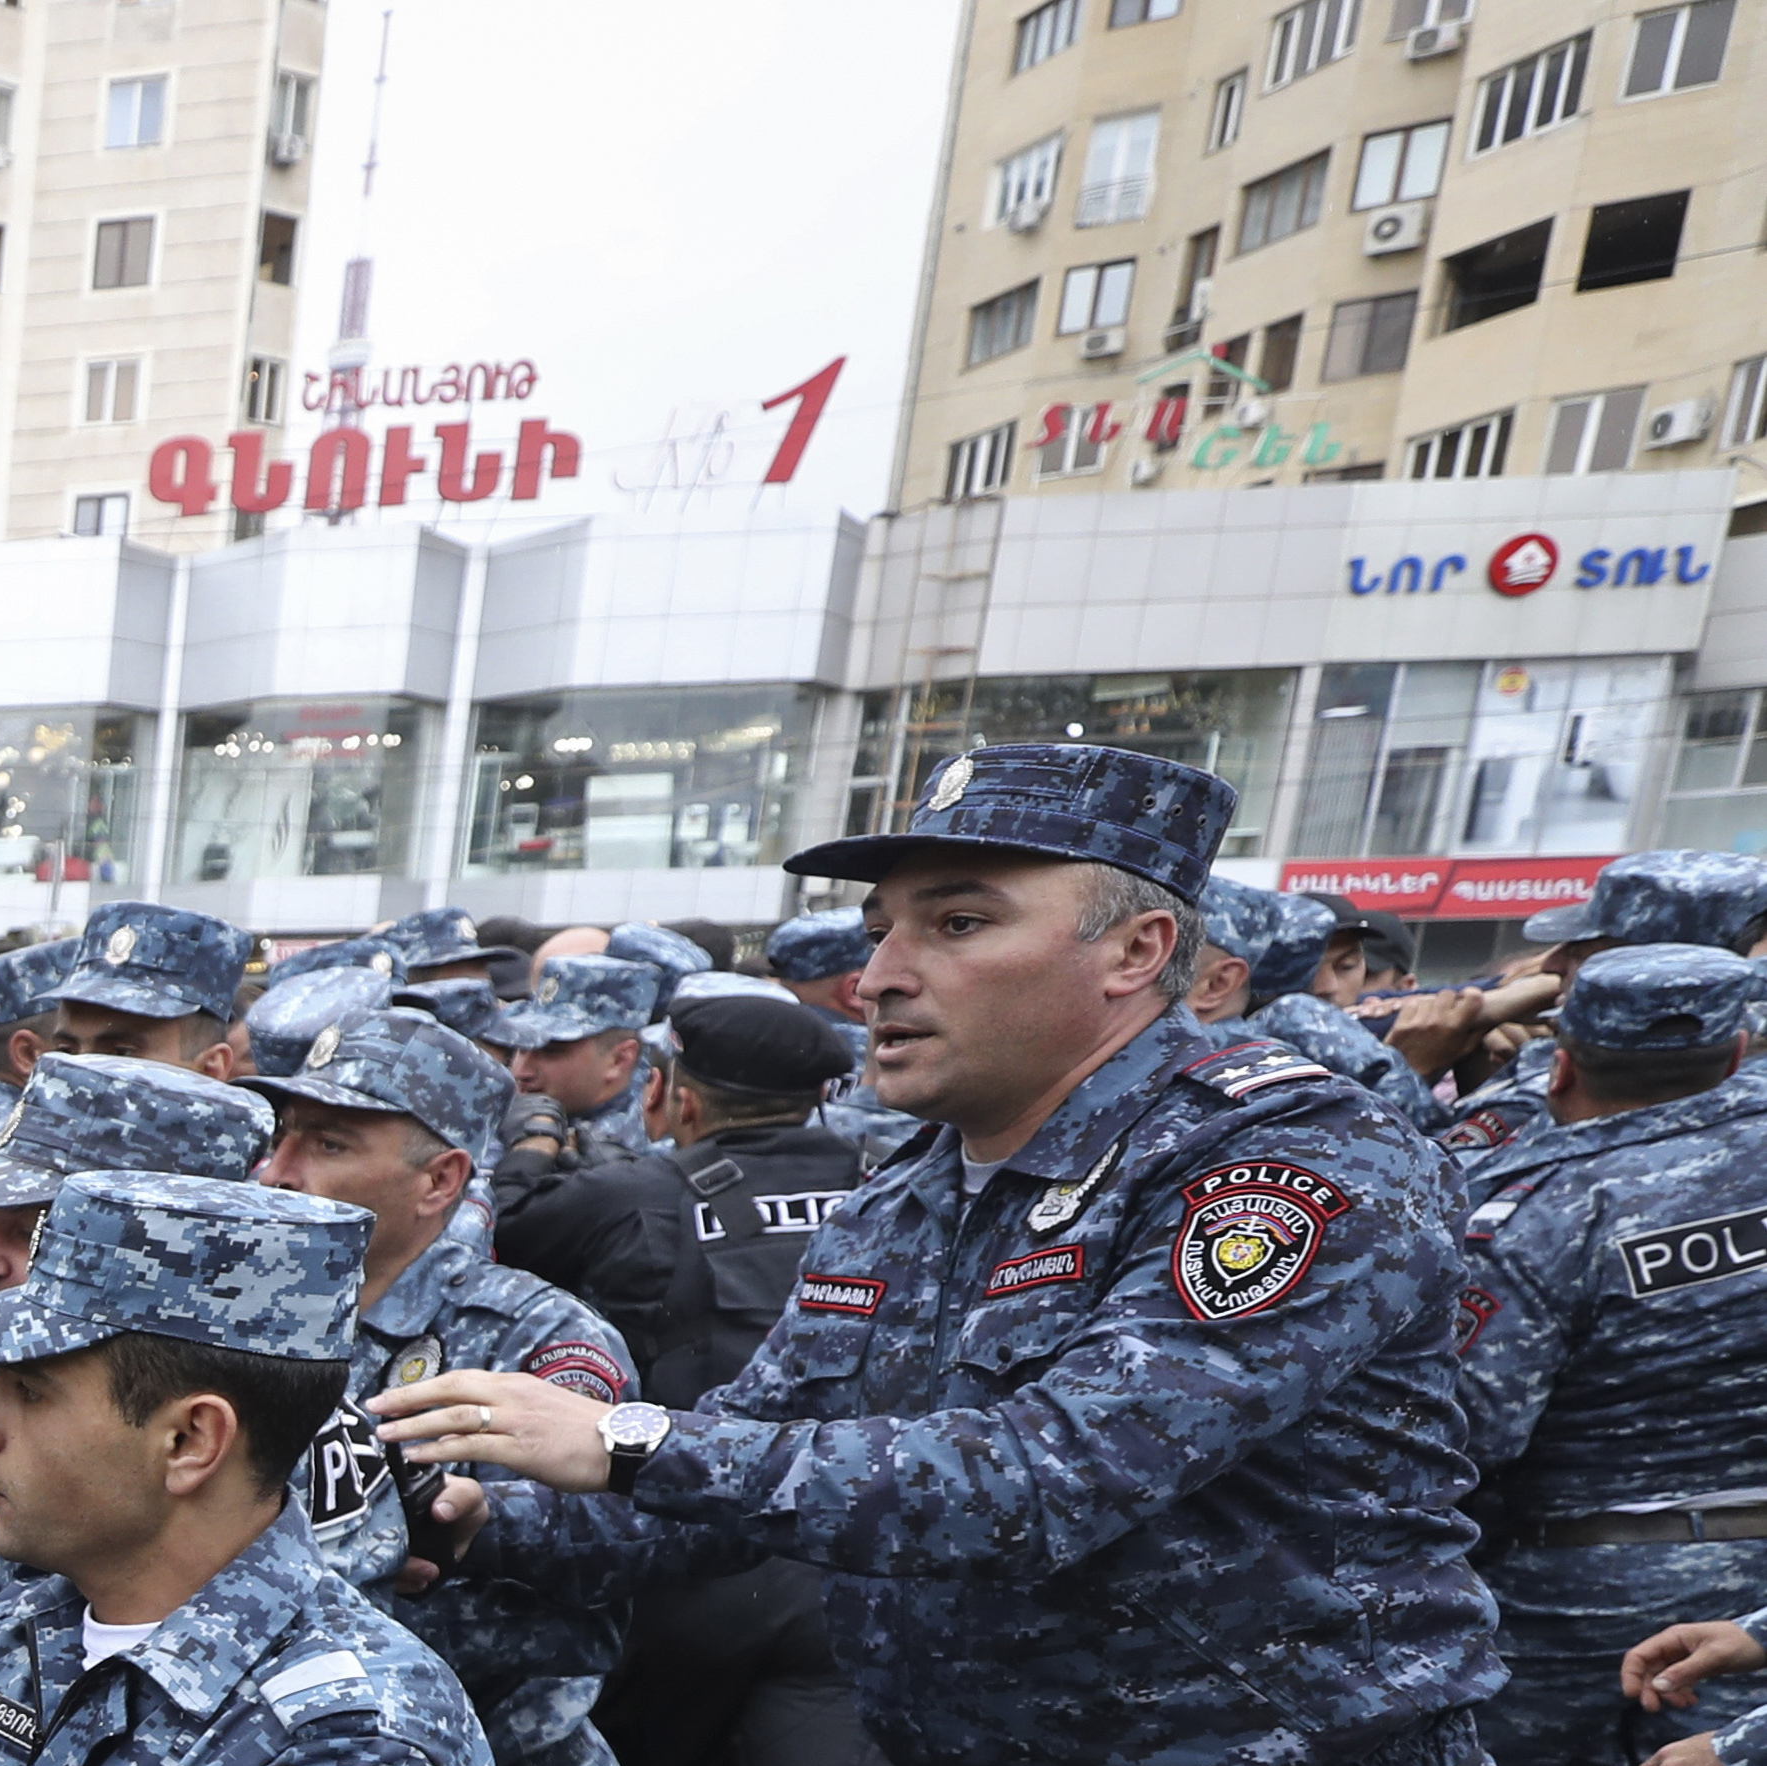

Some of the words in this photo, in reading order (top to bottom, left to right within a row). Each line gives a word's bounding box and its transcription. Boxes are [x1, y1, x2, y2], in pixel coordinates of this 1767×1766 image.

[304, 358, 539, 412] ՇԻՆԱՆՅՈՒԹ
[149, 417, 584, 517] ԳՆՈՒՆԻ
[762, 355, 848, 484] 1
[1349, 554, 1466, 595] ՆՈՐ
[1576, 543, 1711, 588] ՏՈՒՆ
[1452, 876, 1594, 902] ՊԱՍՏԱՌՆ
[1203, 1166, 1334, 1205] POLICE
[1201, 1198, 1304, 1235] ՀԱՅԱՍՏԱՆ
[1186, 1240, 1299, 1308] ՈՍՏԻԿԱՆՈՒԹՅՈՒՆ
